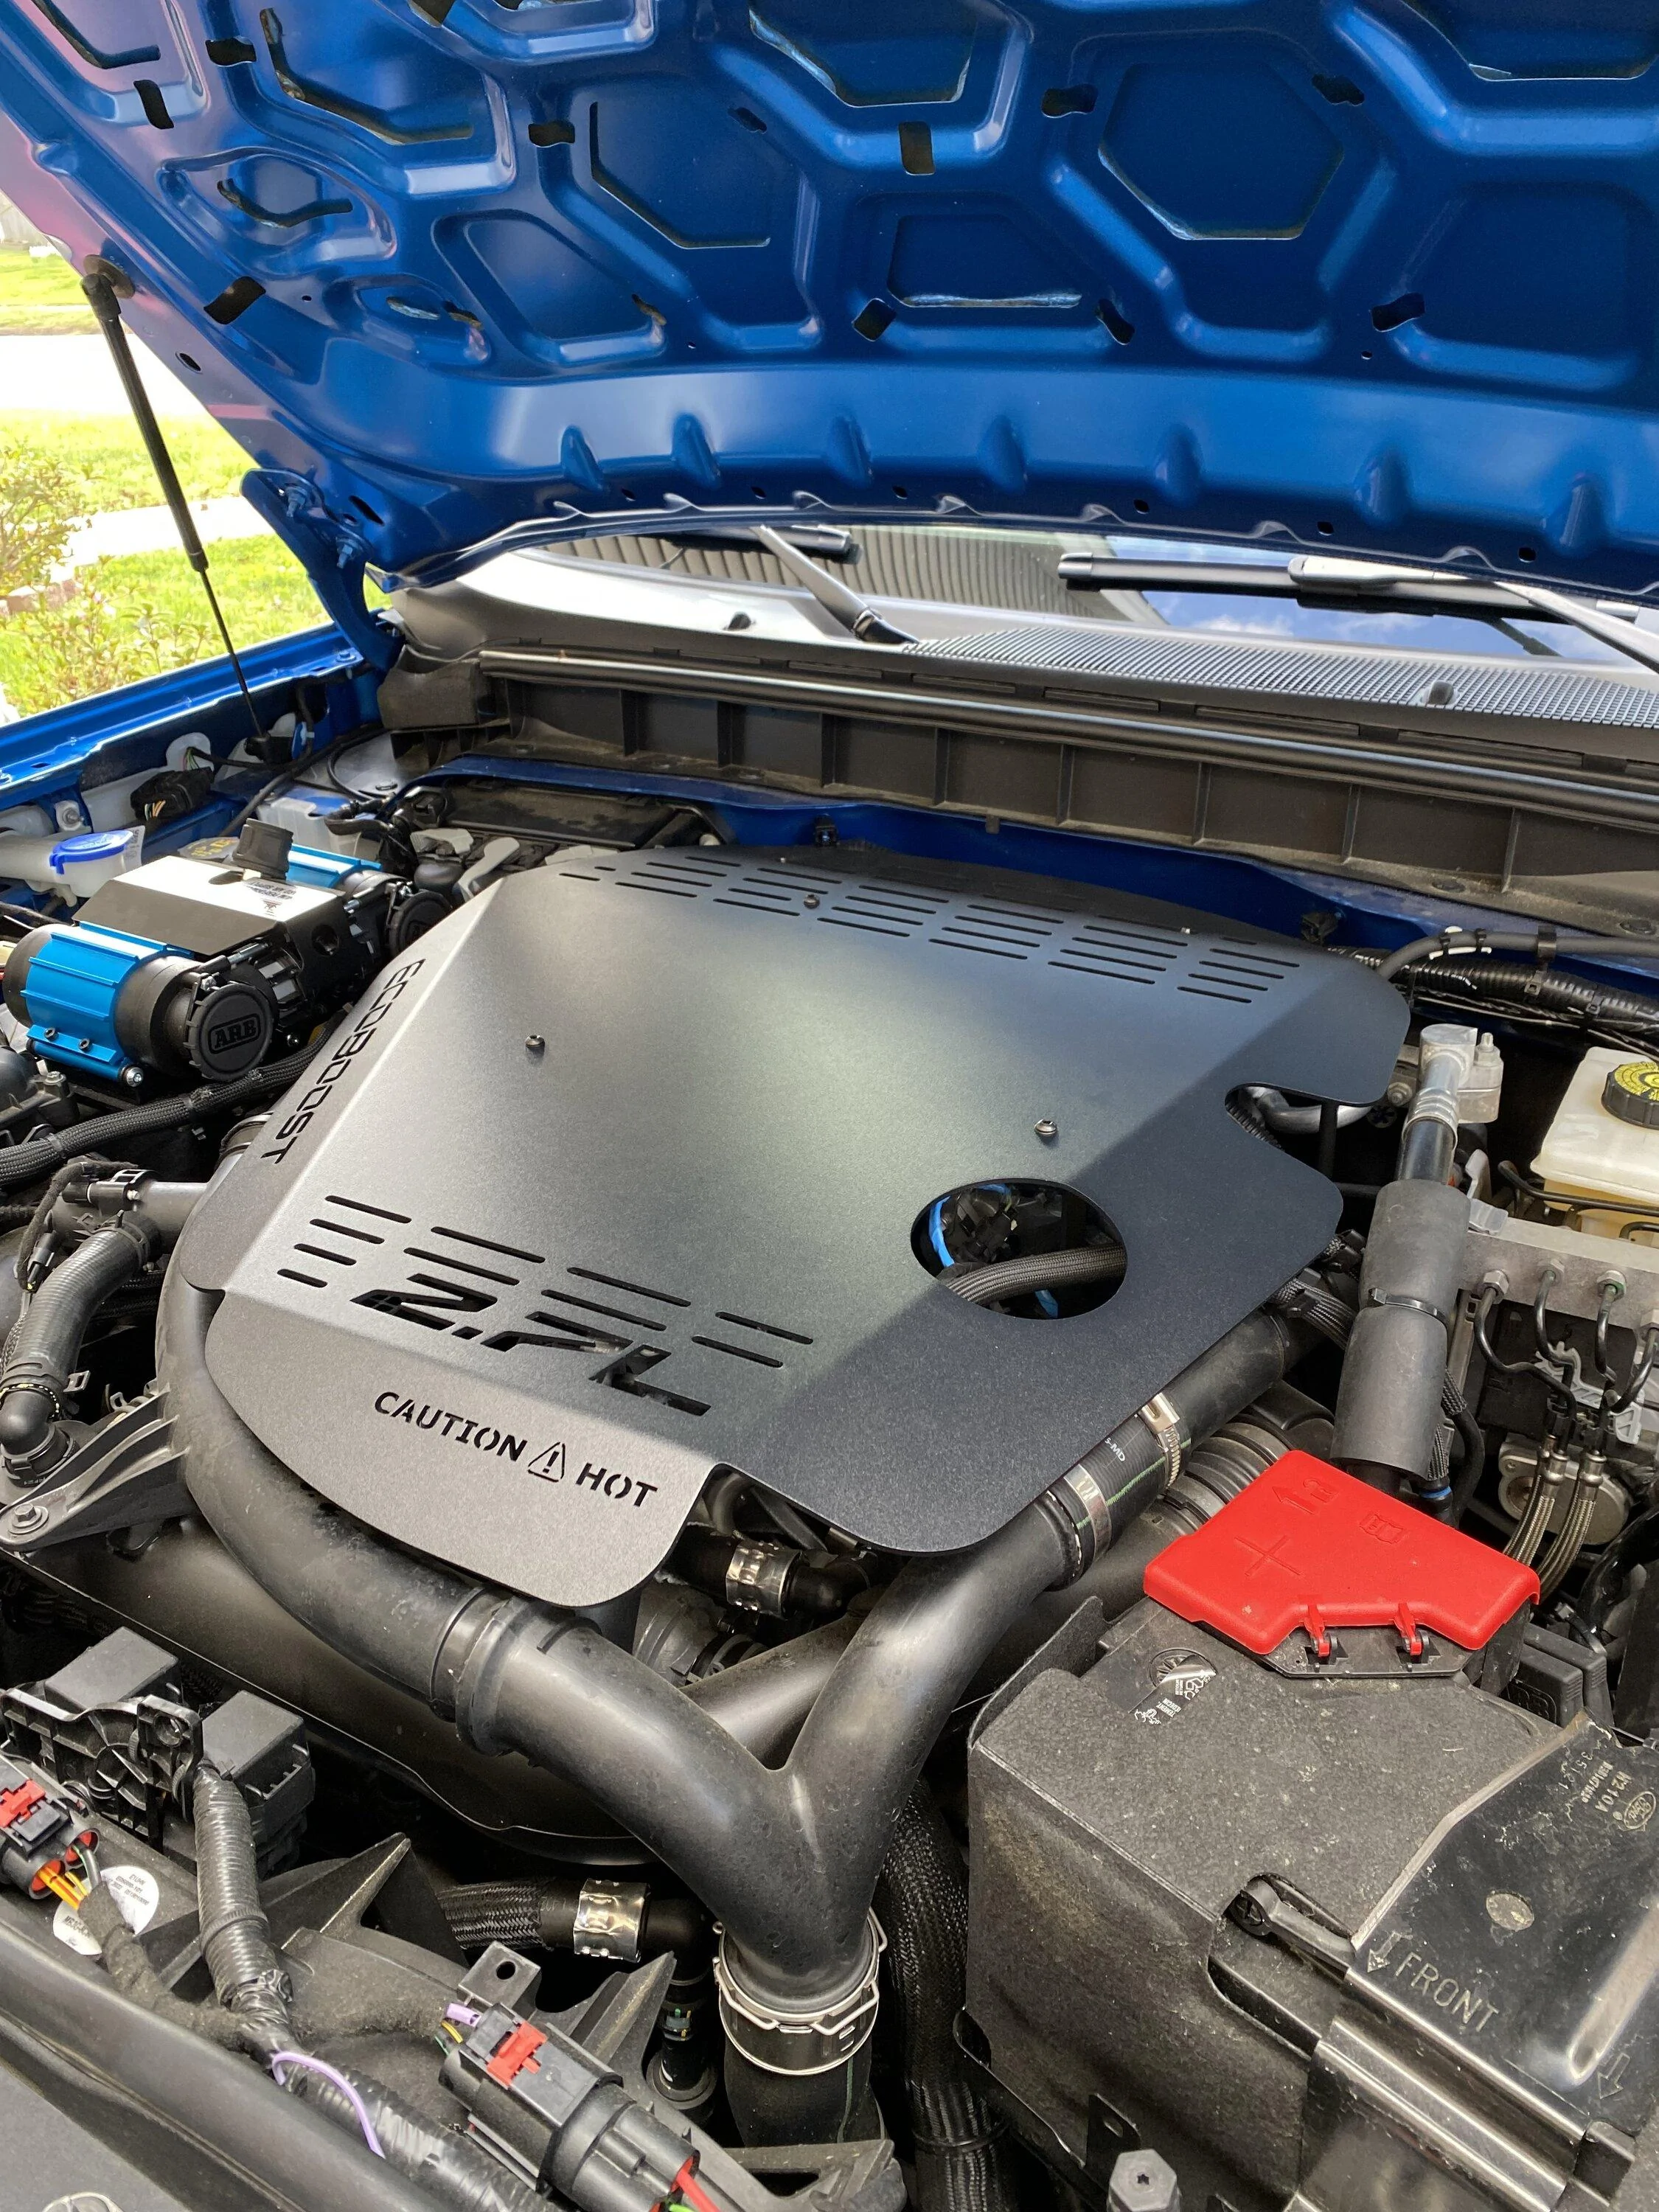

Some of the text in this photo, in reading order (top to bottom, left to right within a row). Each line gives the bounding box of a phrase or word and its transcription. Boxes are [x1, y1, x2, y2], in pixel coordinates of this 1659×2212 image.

[214, 1019, 257, 1049] ARB
[260, 958, 425, 1164] ECOBOOST
[349, 1273, 712, 1417] 2.7L
[374, 1391, 658, 1508] CAUTION HOT
[1394, 1952, 1500, 2032] FRONT
